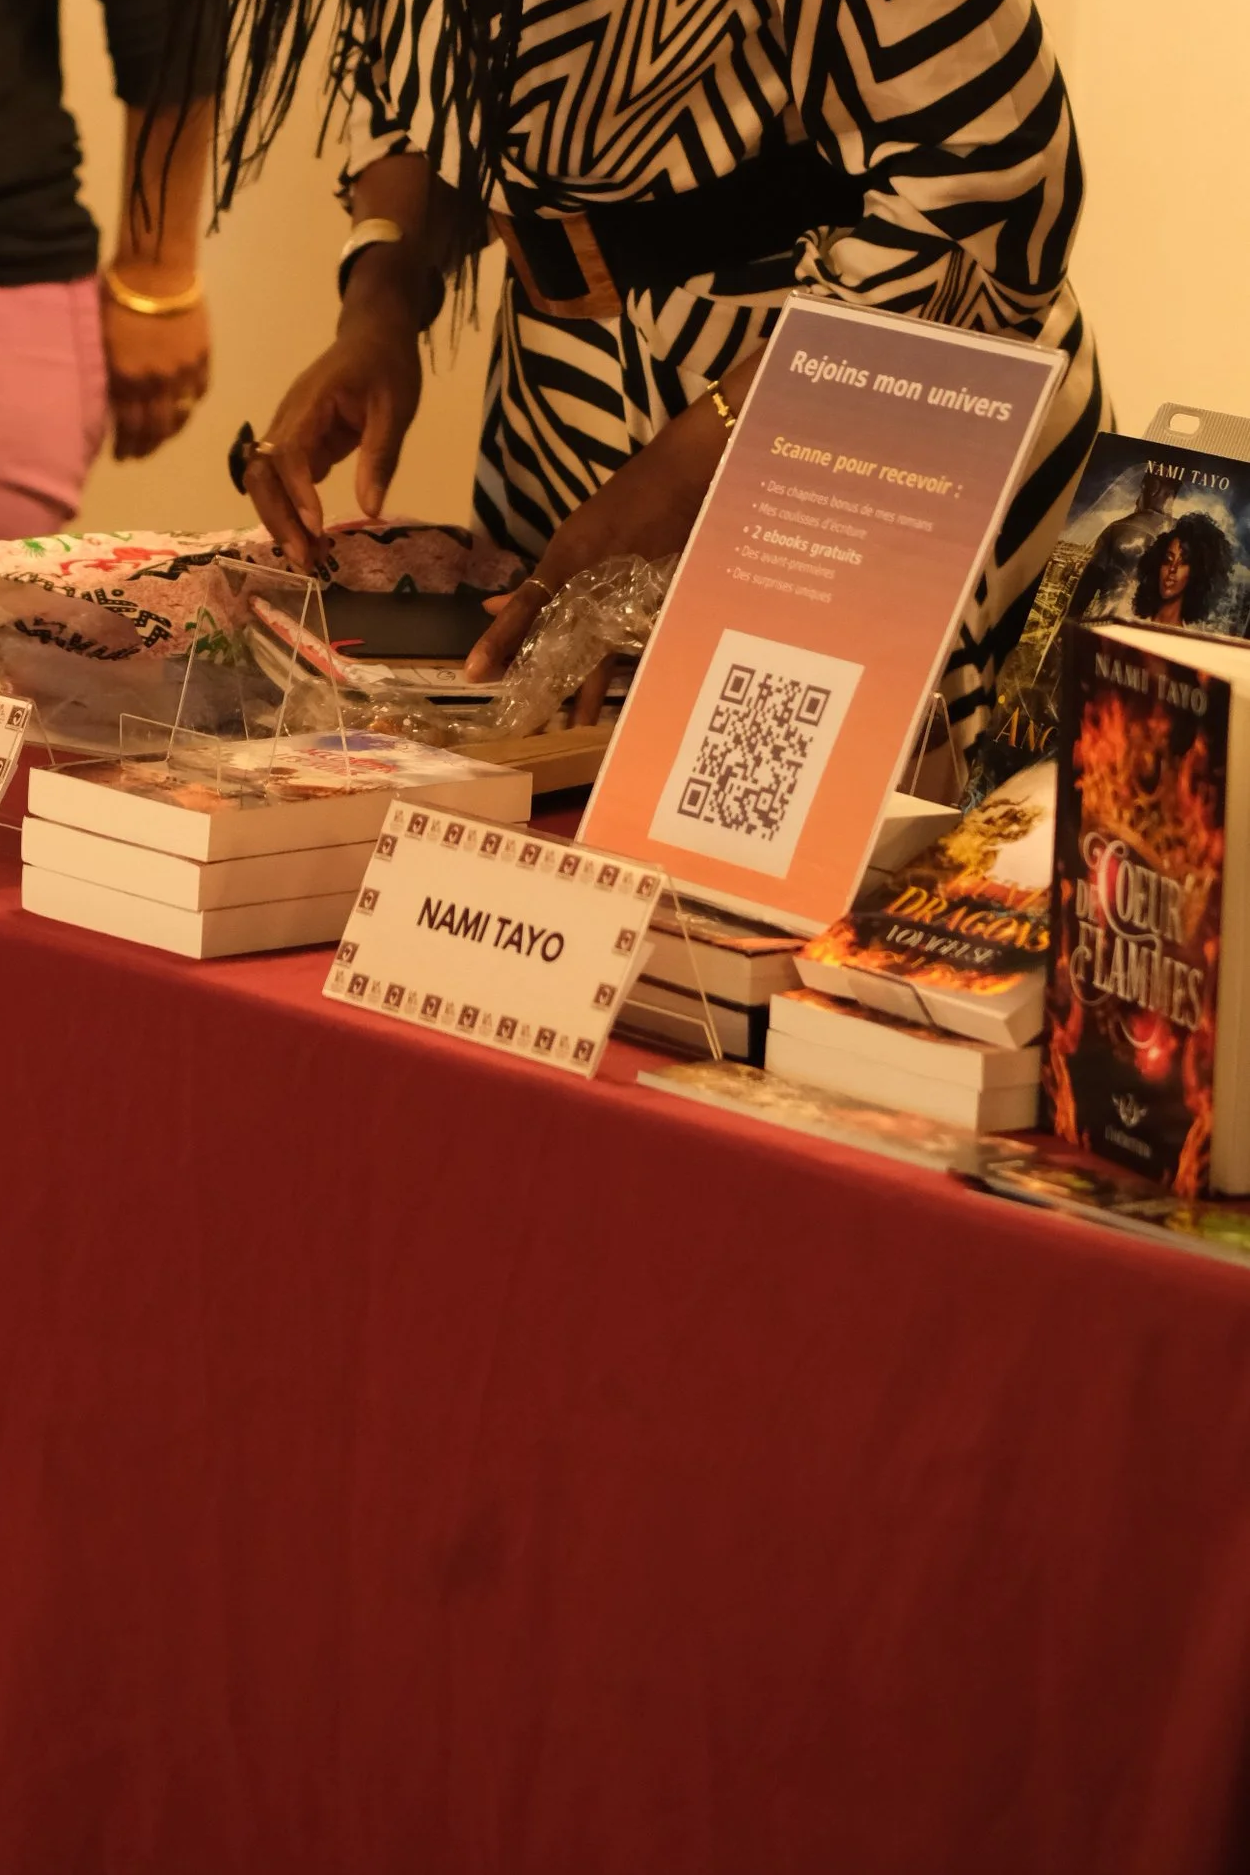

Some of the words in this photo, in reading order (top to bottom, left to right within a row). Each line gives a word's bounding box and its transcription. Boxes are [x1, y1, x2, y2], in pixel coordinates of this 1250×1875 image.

[789, 349, 870, 389] Rejoins
[872, 373, 923, 401] mon
[927, 386, 1013, 422] univers
[770, 436, 832, 467] Scanne
[833, 452, 877, 477] pour
[878, 463, 953, 497] recevoir
[1145, 460, 1184, 482] NAMI
[1190, 469, 1231, 492] TAYO
[758, 501, 778, 518] Mes
[766, 480, 786, 496] Des
[786, 484, 830, 507] chapitres
[830, 494, 859, 514] bonus
[860, 502, 874, 518] de
[875, 509, 896, 524] mes
[740, 544, 760, 561] Des
[751, 524, 763, 540] 2
[762, 528, 809, 552] ebooks
[810, 541, 863, 566] gratuits
[732, 566, 752, 582] Des
[750, 571, 794, 594] surprises
[1095, 652, 1150, 695] NAMI
[1156, 672, 1208, 717] TAYO
[416, 895, 491, 943] NAMI
[492, 916, 565, 963] TAYO
[883, 885, 1051, 953] DRAGONS
[1070, 920, 1203, 1031] FLAMMES
